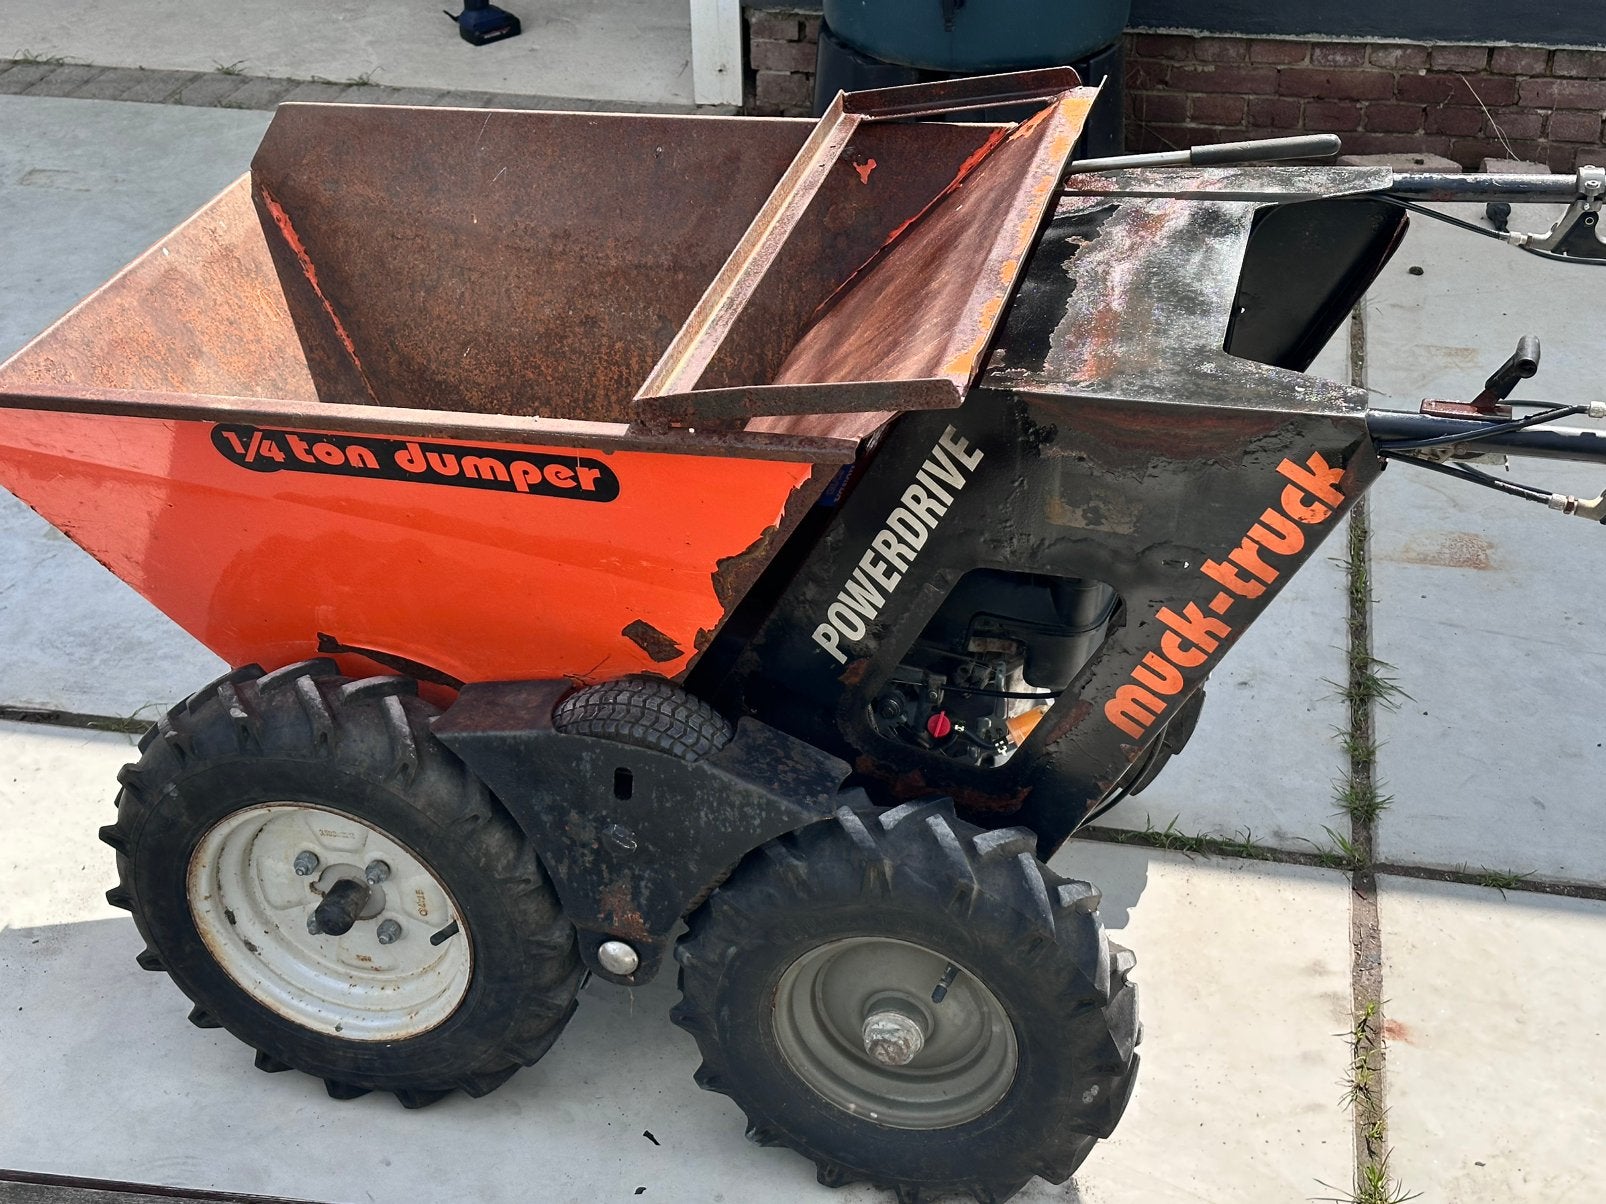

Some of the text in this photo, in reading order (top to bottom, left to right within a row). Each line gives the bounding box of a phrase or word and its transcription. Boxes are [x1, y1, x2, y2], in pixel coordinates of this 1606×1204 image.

[222, 430, 601, 493] 1/4 ton dumper
[811, 424, 985, 665] POWERDRIVE
[1104, 451, 1346, 739] muck-truck
